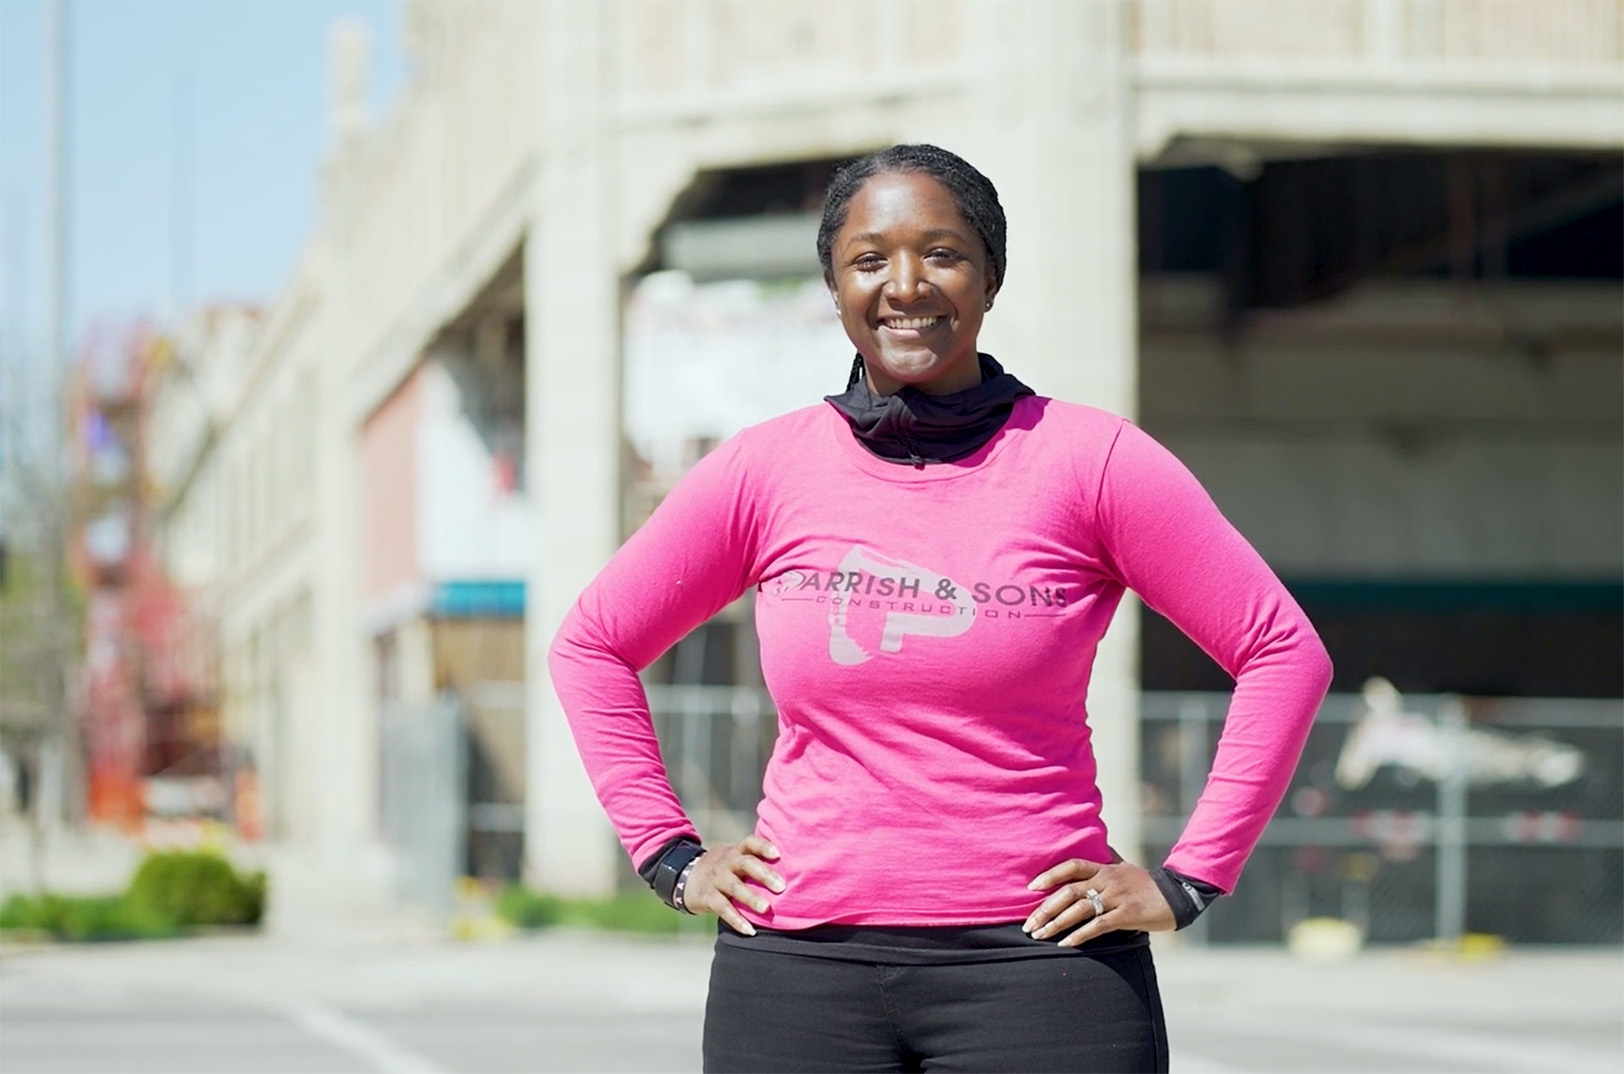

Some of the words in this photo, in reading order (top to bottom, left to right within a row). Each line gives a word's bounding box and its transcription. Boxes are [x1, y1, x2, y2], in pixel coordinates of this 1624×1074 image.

[934, 578, 957, 600] &
[971, 582, 1067, 608] SONS
[816, 596, 1021, 619] CONSTRUCTION
